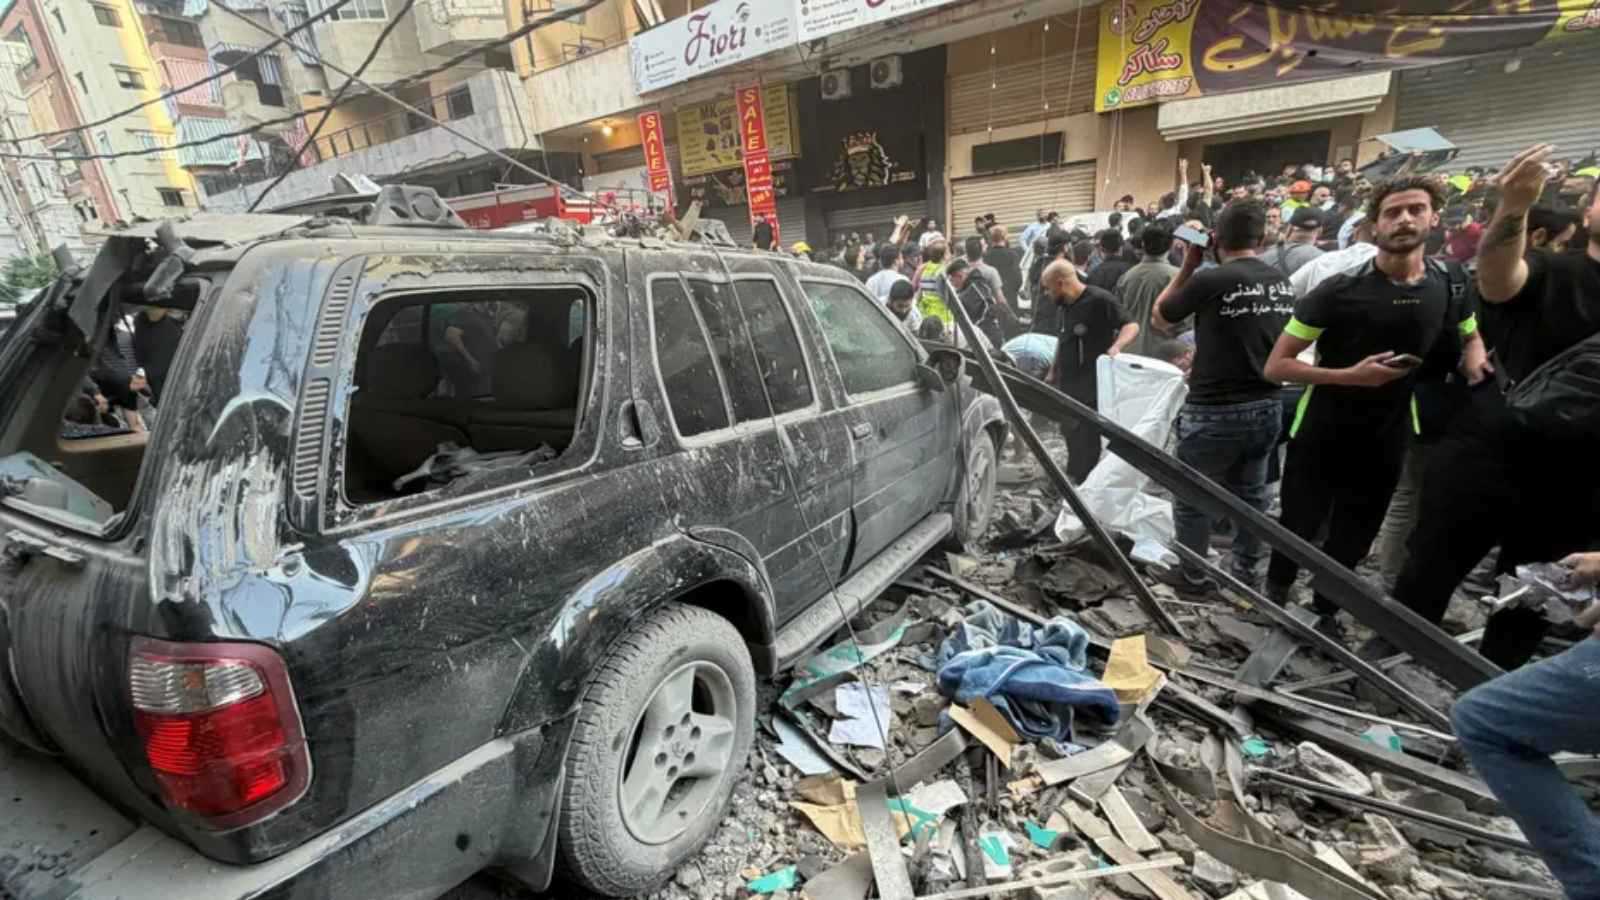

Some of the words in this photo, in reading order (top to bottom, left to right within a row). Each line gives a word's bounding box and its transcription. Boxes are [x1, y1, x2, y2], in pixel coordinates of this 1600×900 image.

[684, 12, 746, 66] Fiori
[645, 115, 662, 170] SALE
[743, 89, 761, 150] SALE
